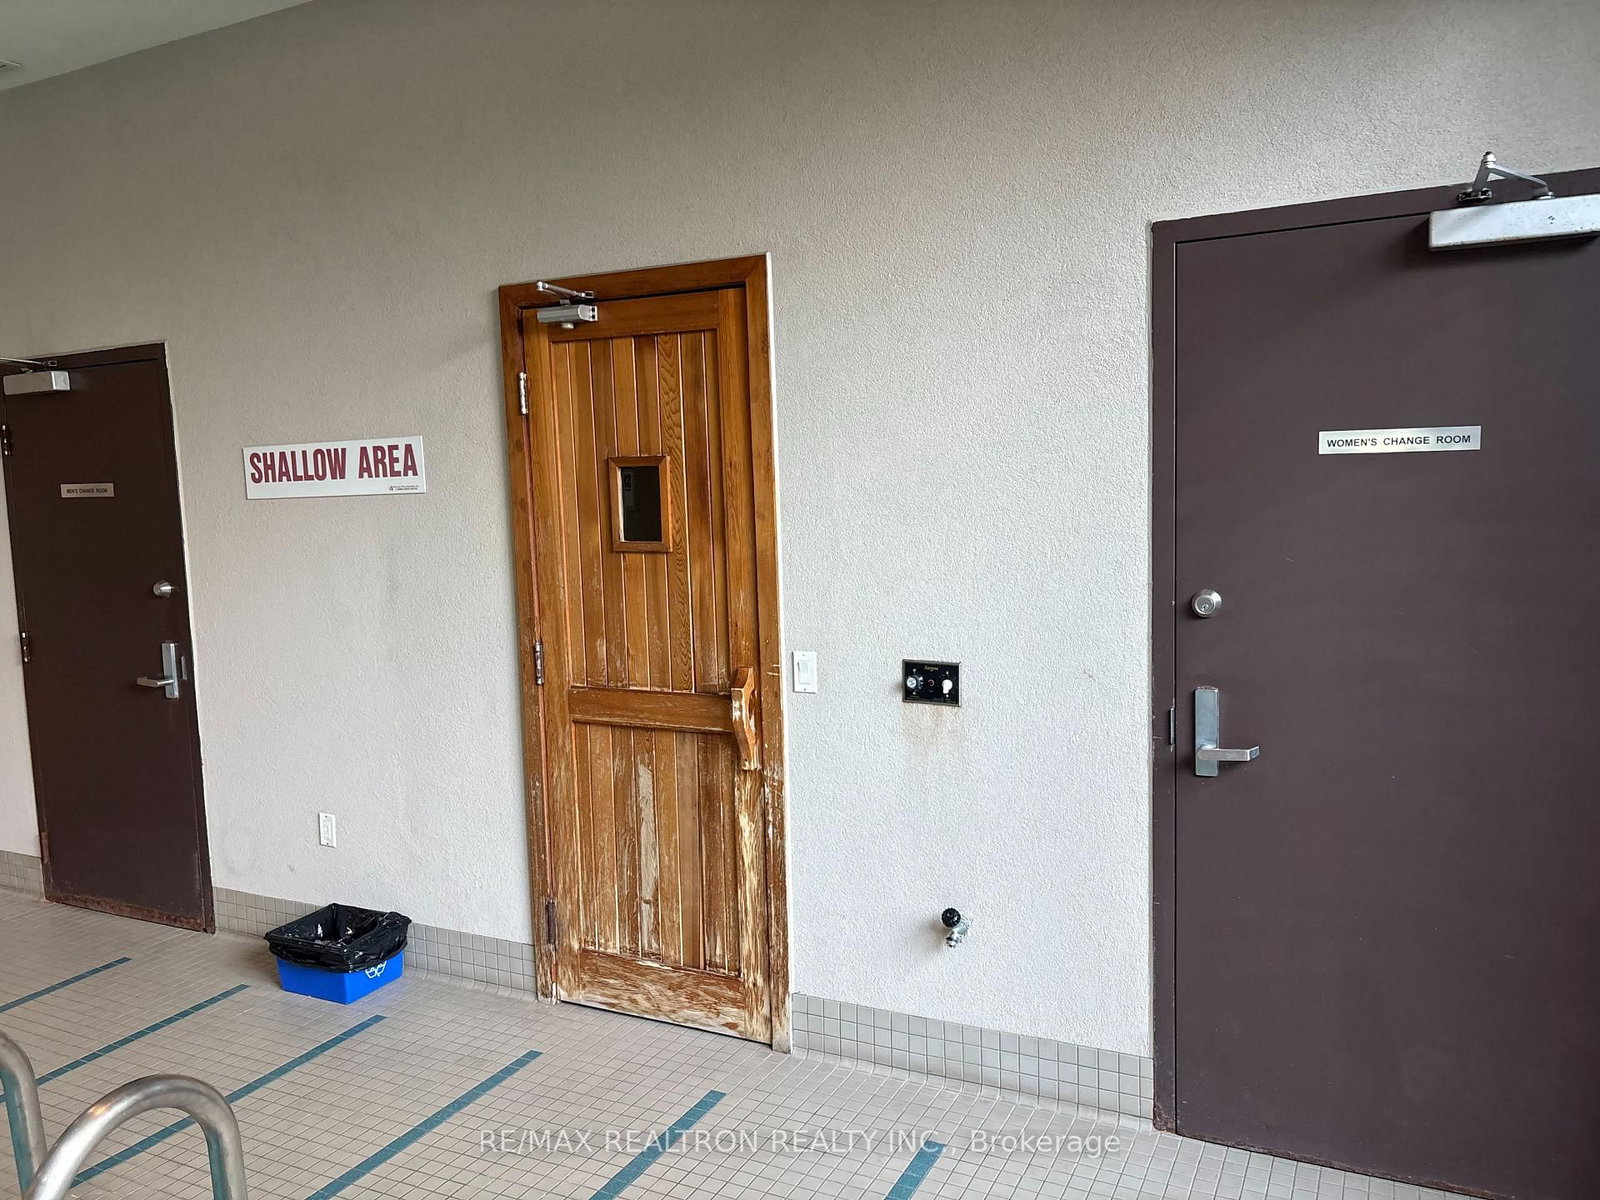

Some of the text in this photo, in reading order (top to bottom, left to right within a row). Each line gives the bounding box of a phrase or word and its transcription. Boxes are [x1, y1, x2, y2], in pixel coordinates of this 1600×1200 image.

[1327, 435, 1471, 447] WOMEN'S CHANGE ROOM
[249, 443, 418, 484] SHALLOW AREA
